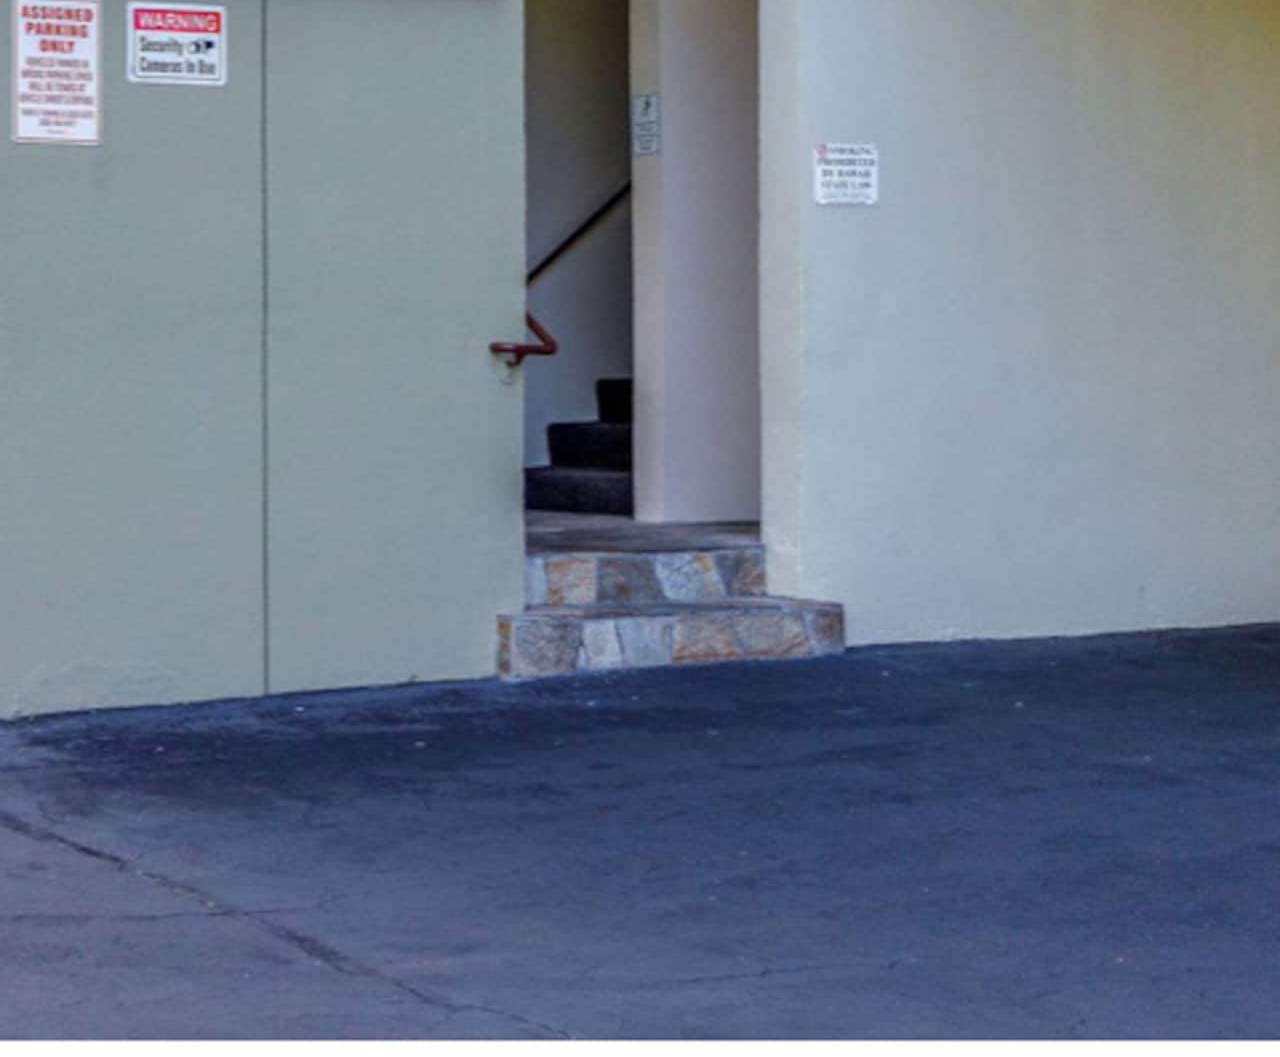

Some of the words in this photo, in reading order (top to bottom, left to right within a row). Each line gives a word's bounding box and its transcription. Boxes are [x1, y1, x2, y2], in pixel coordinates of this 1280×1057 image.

[21, 5, 94, 22] ASSIGNED
[138, 12, 218, 31] WARNING
[25, 21, 89, 38] PARKING
[39, 39, 75, 53] ONLY
[139, 35, 183, 57] Security
